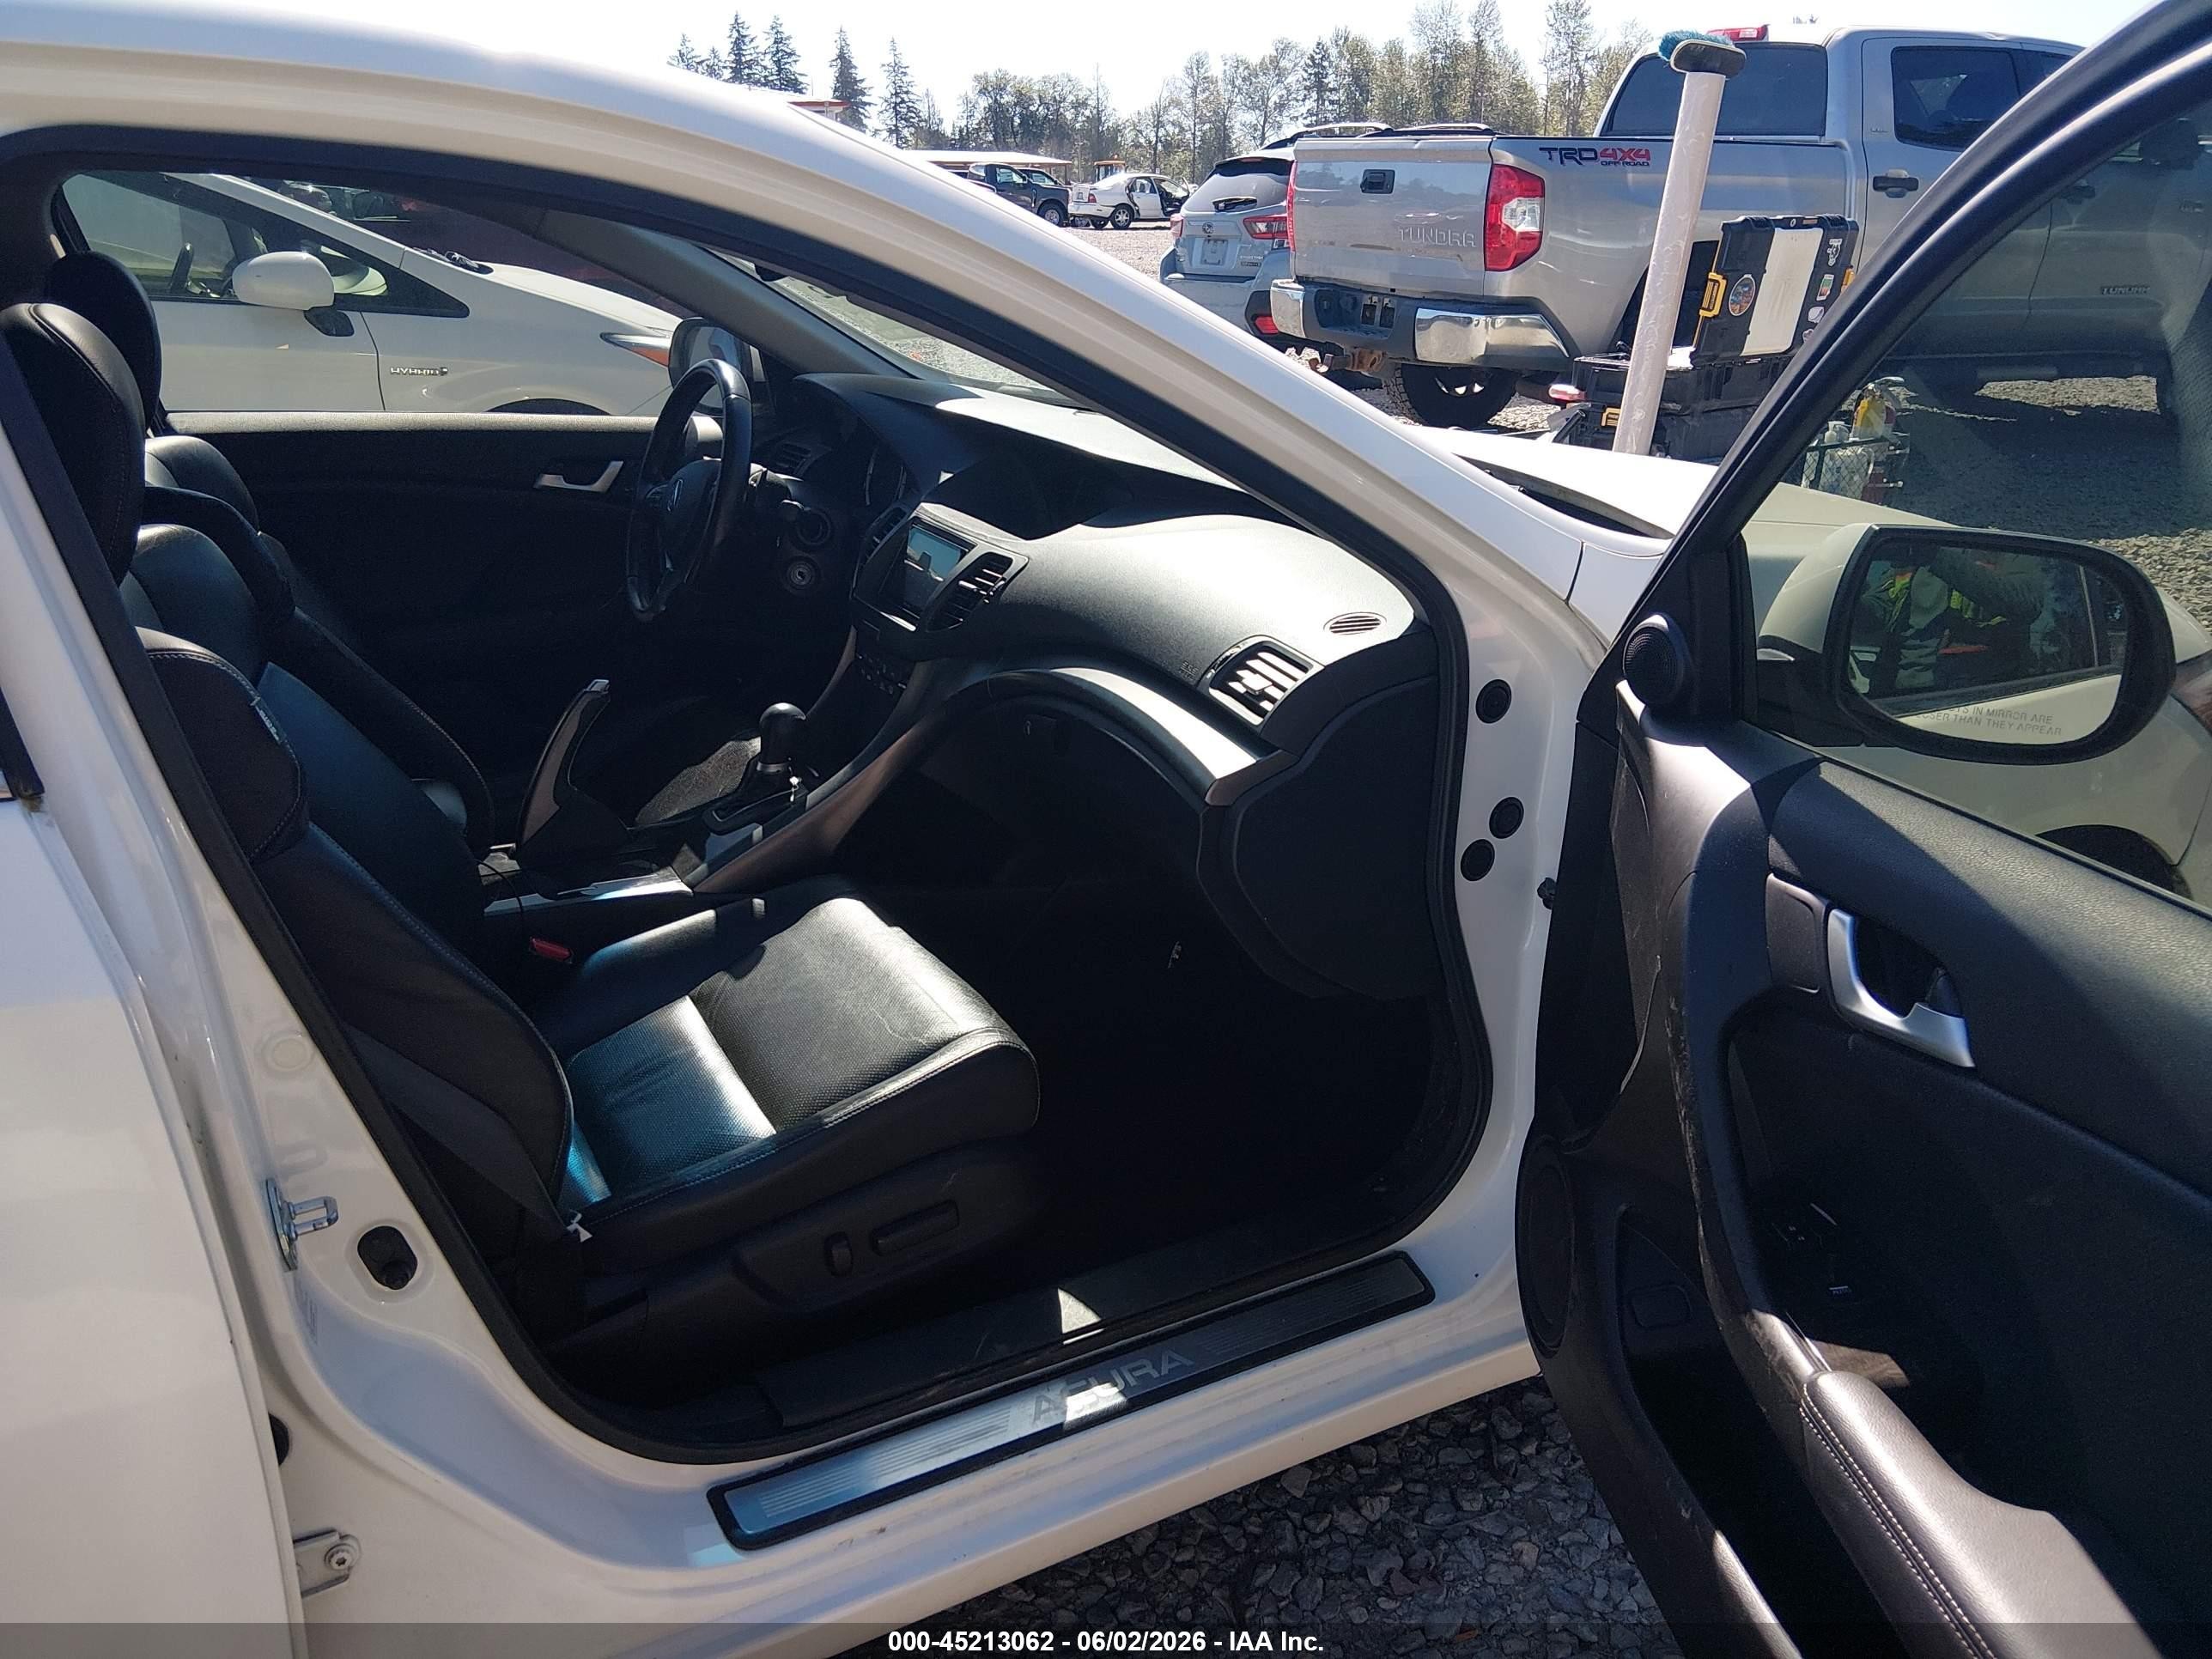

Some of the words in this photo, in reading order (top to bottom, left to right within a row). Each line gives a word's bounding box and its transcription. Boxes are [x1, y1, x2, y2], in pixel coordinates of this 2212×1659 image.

[1539, 147, 1598, 165] TRD
[1600, 148, 1651, 161] 4X4
[1399, 227, 1476, 247] TUNDRA
[390, 367, 439, 375] HYBRID
[1953, 714, 1982, 726] THAN
[1986, 718, 2014, 730] THEY
[2015, 723, 2063, 736] APPEAR
[1972, 707, 1984, 715] IN
[1985, 708, 2027, 722] MIRROR
[2030, 714, 2054, 725] ARE
